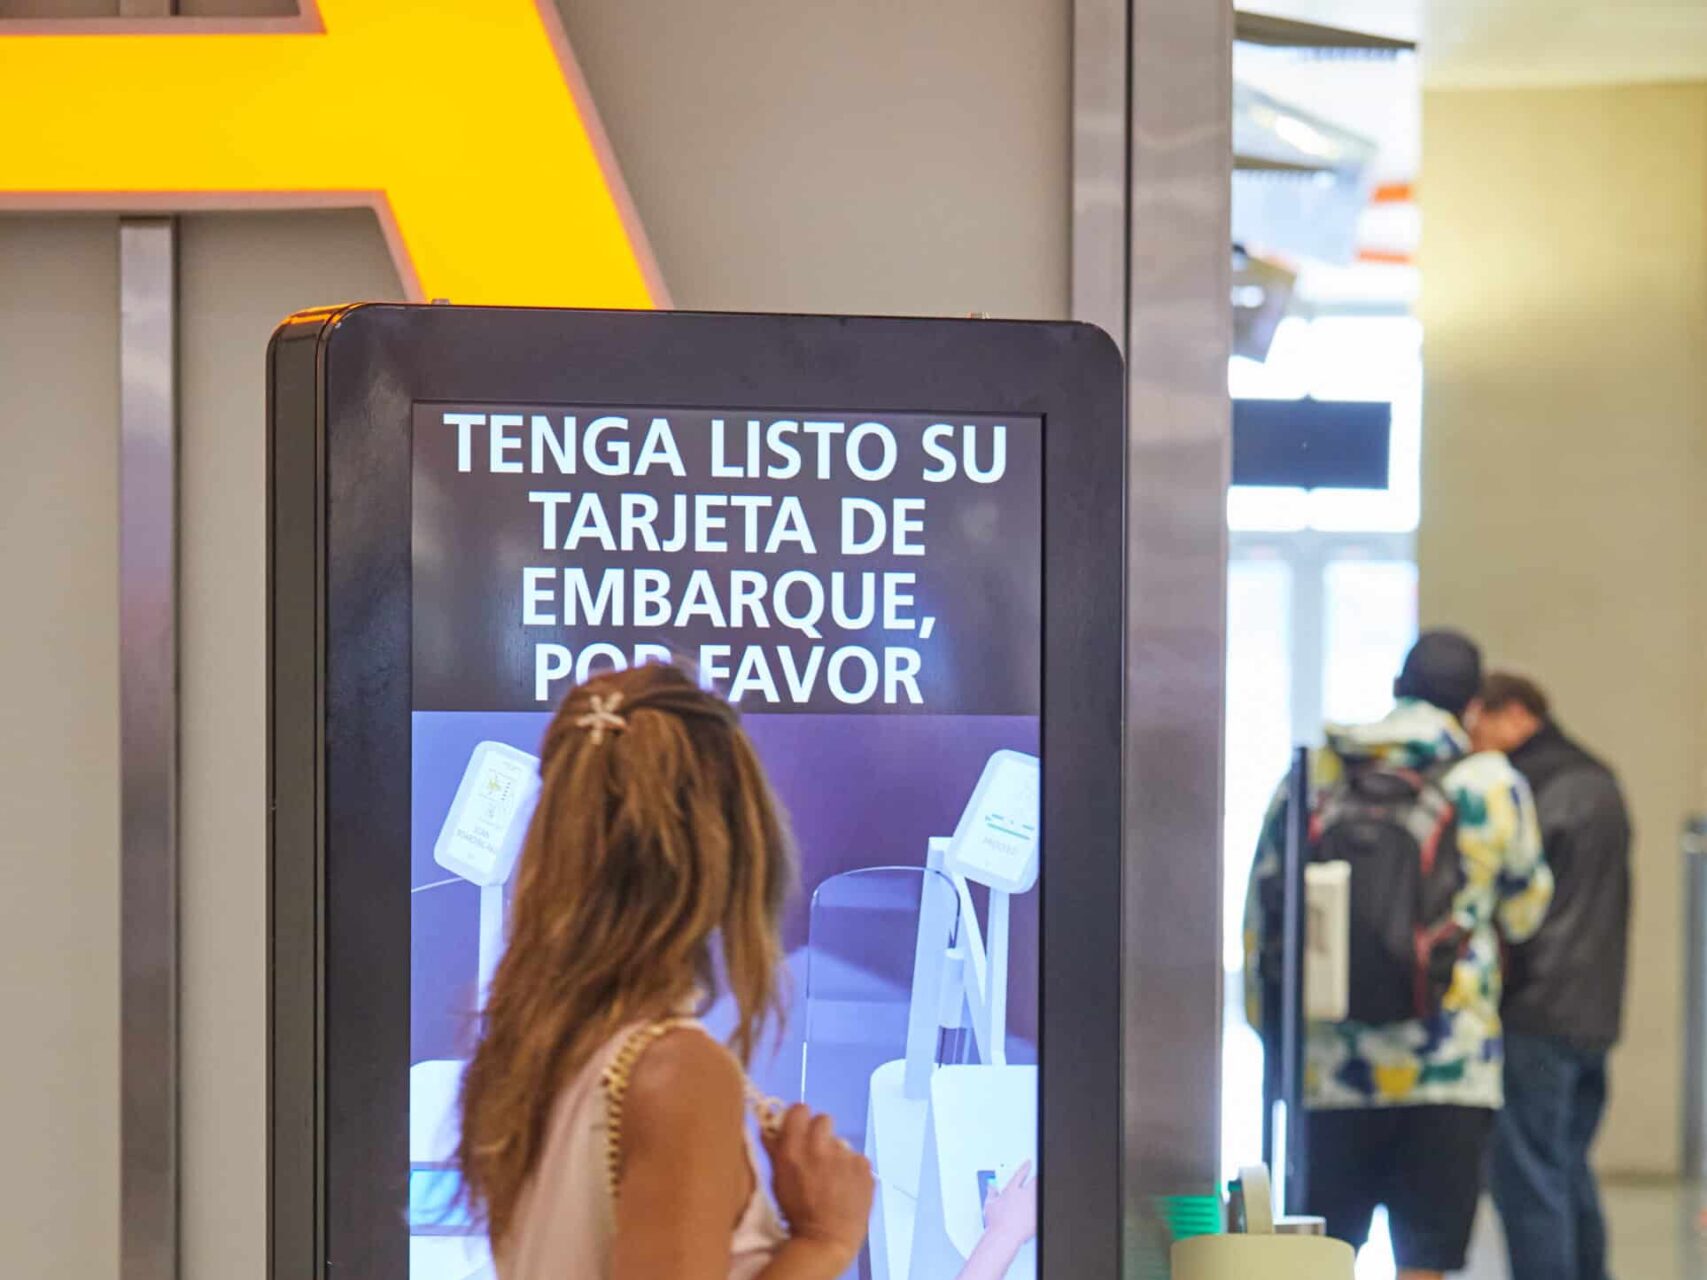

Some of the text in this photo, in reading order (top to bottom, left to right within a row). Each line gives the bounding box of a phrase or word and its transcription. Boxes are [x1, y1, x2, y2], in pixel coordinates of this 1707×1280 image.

[443, 413, 1007, 484] TENGA LISTO SU
[528, 491, 926, 556] TARJETA DE
[522, 566, 936, 639] EMBARQUE,
[699, 644, 924, 705] FAVOR
